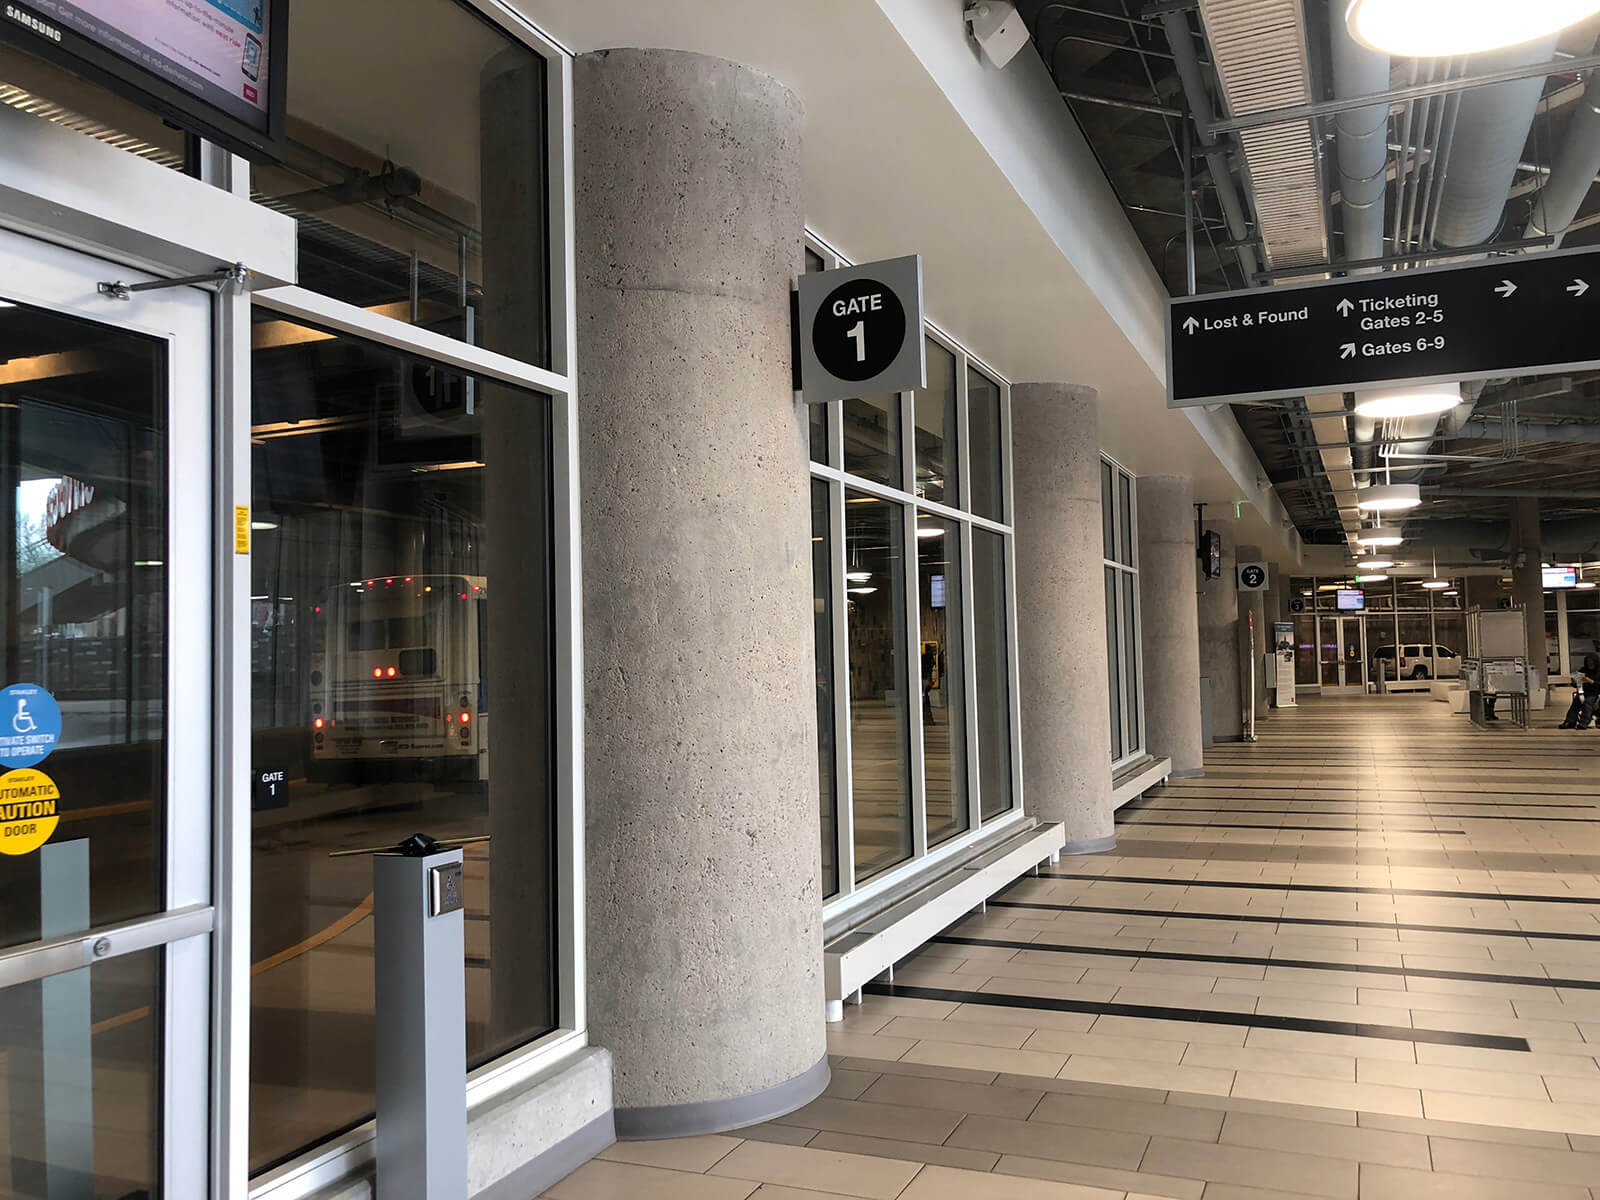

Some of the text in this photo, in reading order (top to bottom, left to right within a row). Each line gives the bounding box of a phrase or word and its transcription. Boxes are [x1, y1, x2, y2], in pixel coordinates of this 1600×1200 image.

[6, 5, 61, 42] SAMSUNG
[832, 294, 882, 316] GATE
[1358, 293, 1438, 313] Ticketing
[1204, 306, 1308, 330] Lost & Found
[1360, 309, 1444, 331] Gates 2-5
[847, 320, 866, 362] 1
[1361, 336, 1445, 357] Gates 6-9
[1249, 574, 1257, 584] 2
[26, 733, 55, 745] SWITCH
[11, 745, 45, 757] OPERATE
[262, 771, 284, 783] GATE
[269, 783, 275, 796] 1
[4, 823, 37, 837] DOOR
